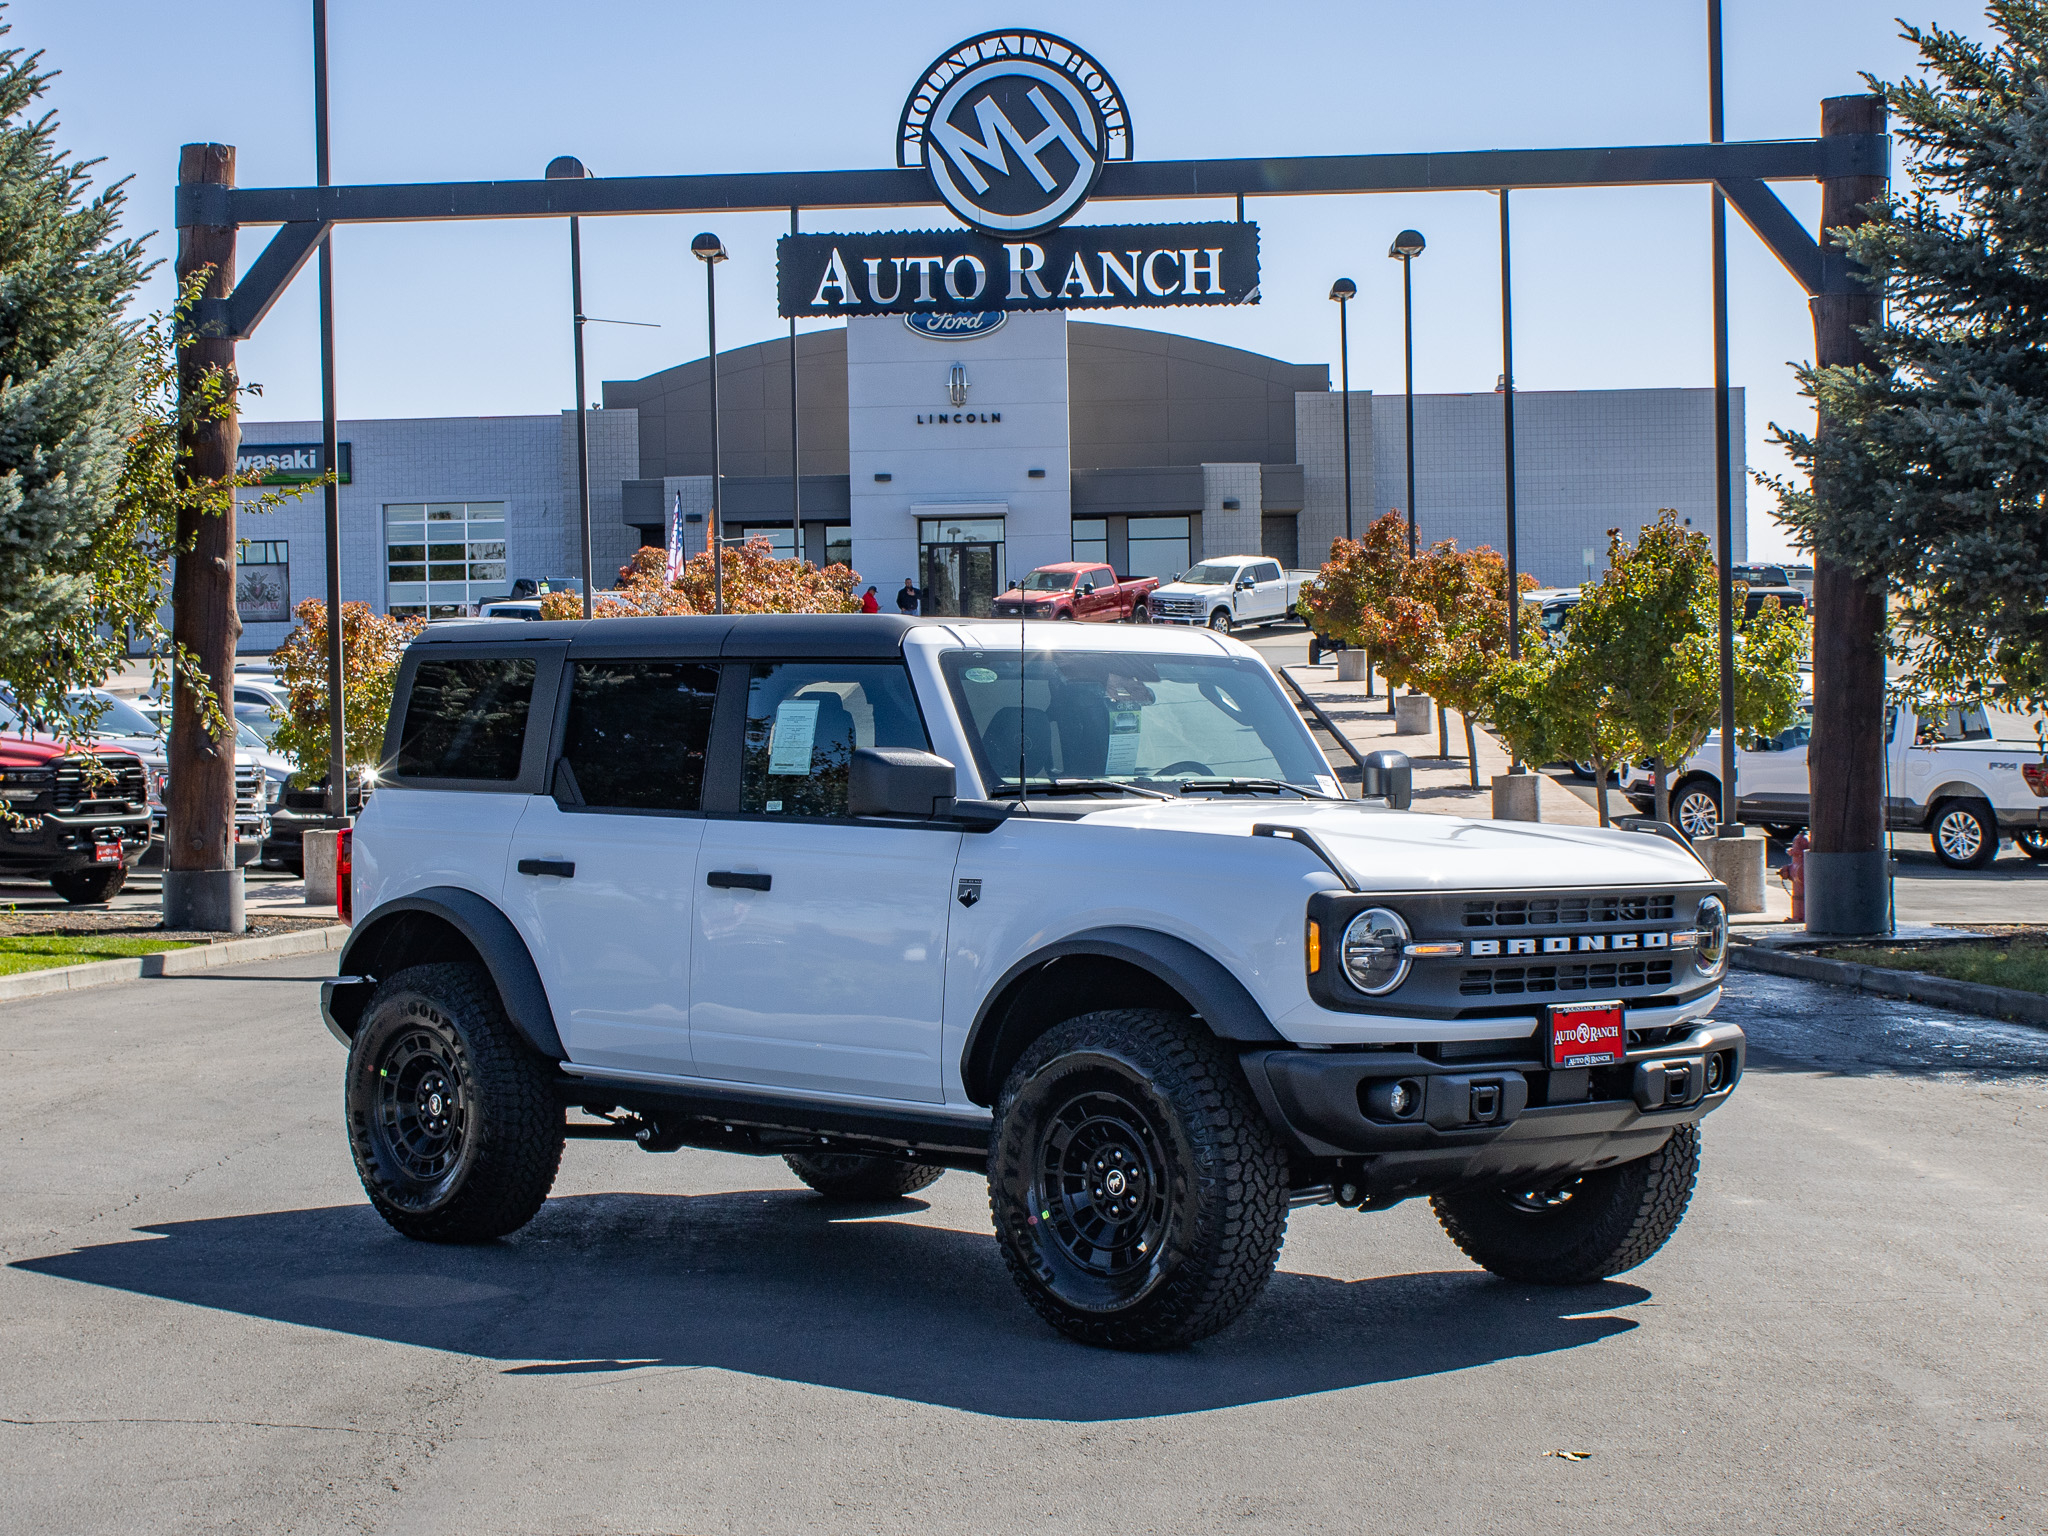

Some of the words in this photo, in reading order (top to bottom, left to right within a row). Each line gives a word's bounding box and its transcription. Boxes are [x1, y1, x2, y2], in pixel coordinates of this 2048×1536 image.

[903, 36, 1052, 144] MOUNTAIN
[1065, 50, 1126, 140] HOME
[810, 247, 987, 305] AUTO
[1002, 242, 1226, 300] RANCH
[926, 311, 985, 331] Ford
[916, 412, 1002, 425] LINCOLN
[236, 449, 317, 470] wasaki
[1988, 762, 2018, 771] FX4
[1470, 932, 1669, 956] BRONCO
[1554, 1029, 1576, 1046] AUTO
[1590, 1026, 1619, 1042] RANCH
